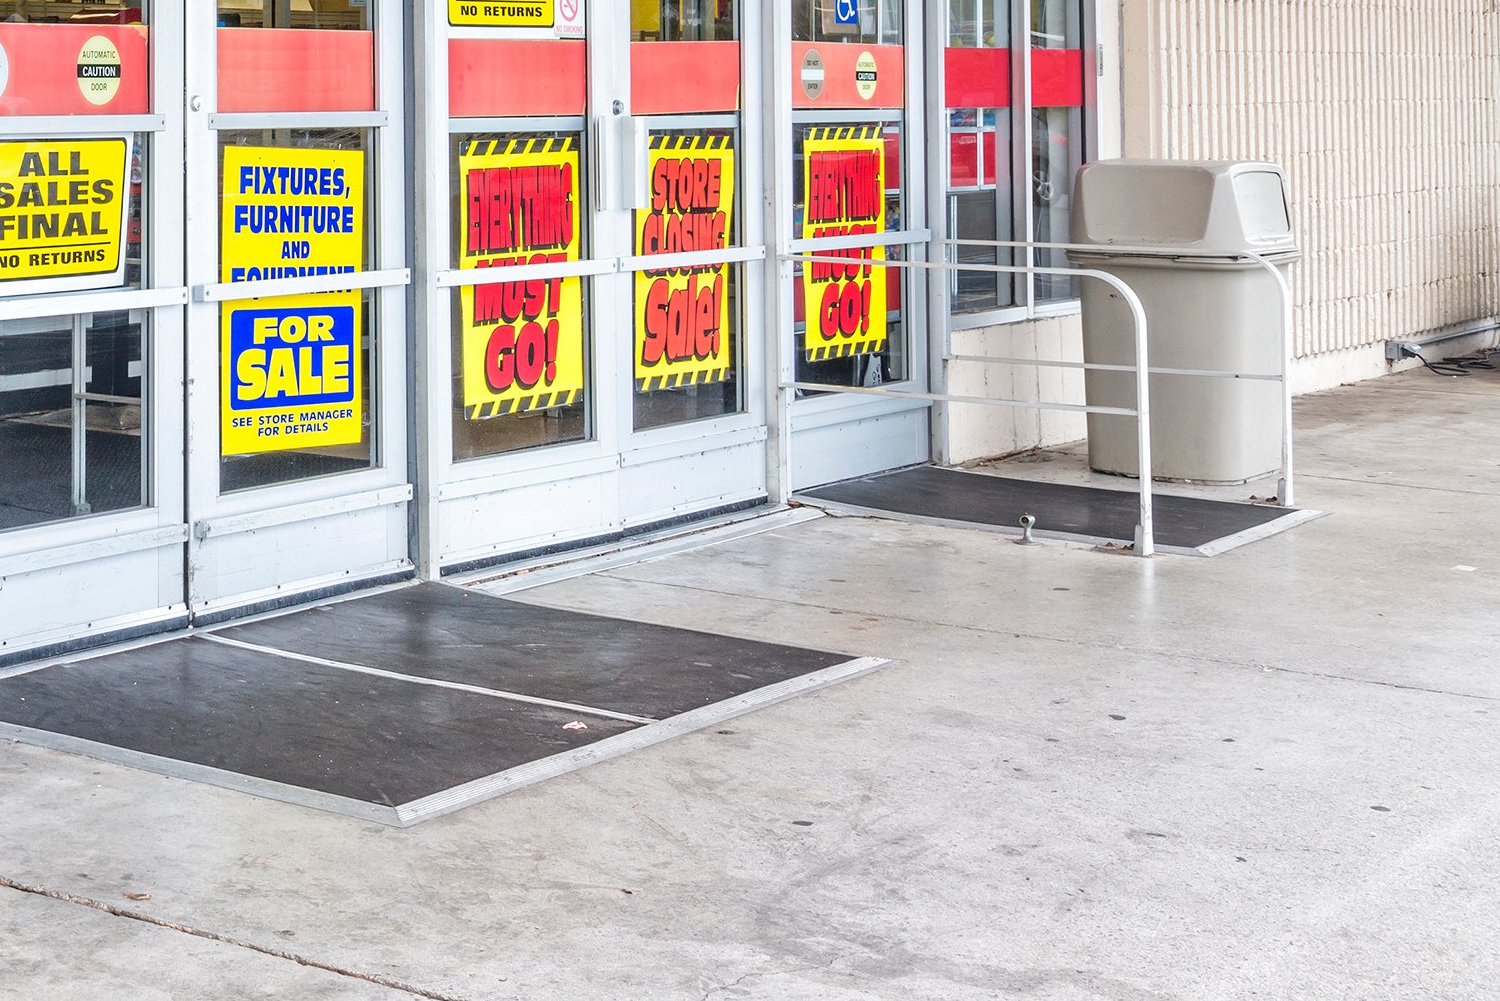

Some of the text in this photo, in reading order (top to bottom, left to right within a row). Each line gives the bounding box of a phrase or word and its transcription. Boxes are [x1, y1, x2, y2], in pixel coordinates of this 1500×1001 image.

[461, 5, 543, 17] NO RETURNS
[556, 25, 583, 34] NO SMOKING
[82, 51, 116, 59] AUTOMATIC
[82, 65, 116, 77] CAUTION
[91, 83, 108, 91] DOOR
[18, 151, 89, 177] ALL
[240, 166, 350, 199] FIXTURES,
[651, 157, 722, 215] STORE
[808, 148, 881, 224] EVERYTHING
[235, 205, 354, 233] FURNITURE
[467, 162, 573, 256] EVERYTHING
[29, 249, 106, 266] RETURNS
[281, 240, 311, 259] AND
[643, 211, 726, 278] CLOSING
[812, 224, 878, 283] MUST
[473, 253, 568, 327] MUST
[641, 274, 723, 367] Sale!
[820, 280, 872, 341] GO!
[253, 315, 335, 344] FOR
[484, 319, 560, 394] GO!
[236, 344, 349, 401] SALE
[232, 409, 353, 427] SEE STORE MANAGER
[258, 422, 329, 437] FOR DETAILS
